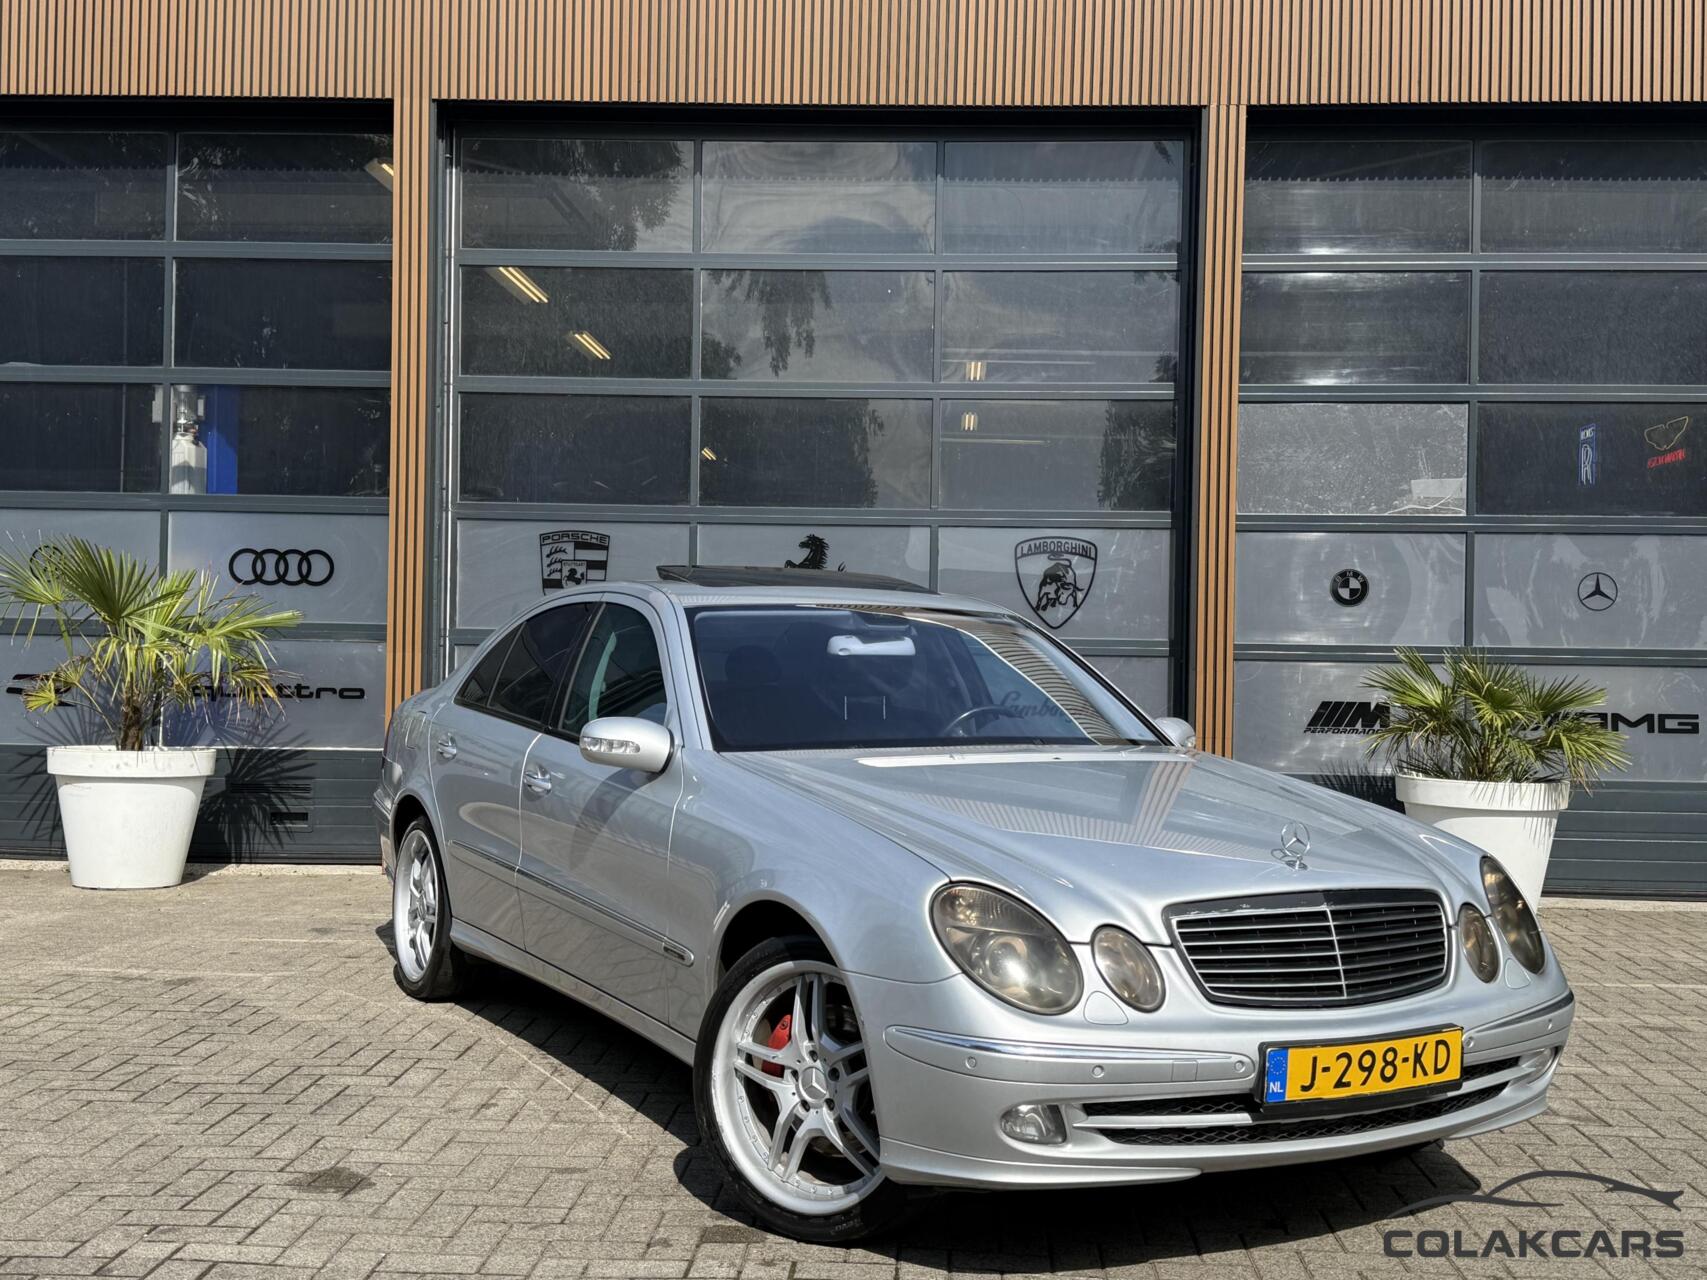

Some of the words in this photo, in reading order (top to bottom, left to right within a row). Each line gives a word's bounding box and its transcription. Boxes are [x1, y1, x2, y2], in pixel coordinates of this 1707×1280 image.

[542, 532, 608, 545] PORSCHE
[1020, 540, 1092, 557] LAMBORGHINI
[1299, 1039, 1451, 1093] J-298-KD
[1268, 1080, 1284, 1093] NL
